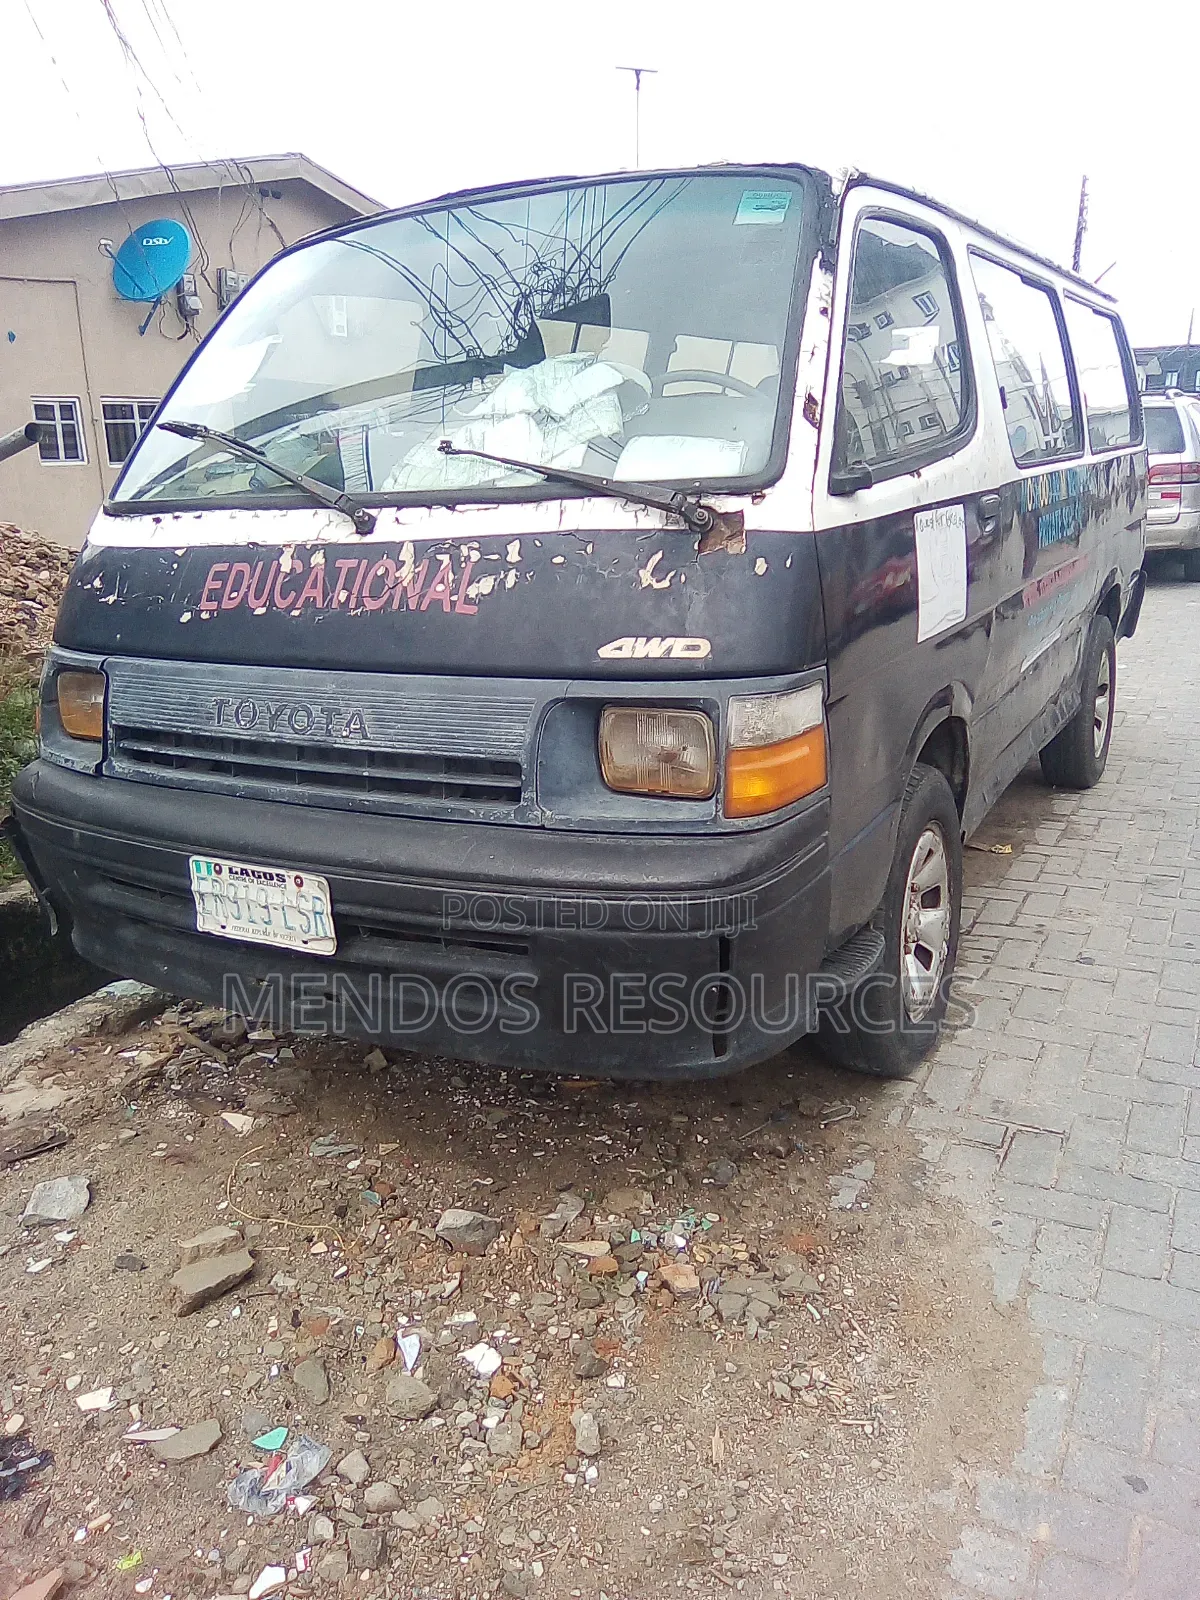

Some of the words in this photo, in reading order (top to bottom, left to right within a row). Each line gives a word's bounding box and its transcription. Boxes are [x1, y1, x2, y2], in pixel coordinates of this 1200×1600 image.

[200, 558, 479, 615] EDUCATIONAL
[597, 636, 712, 659] 4WD
[211, 697, 371, 740] TOYOTA
[228, 866, 287, 883] LAGOS
